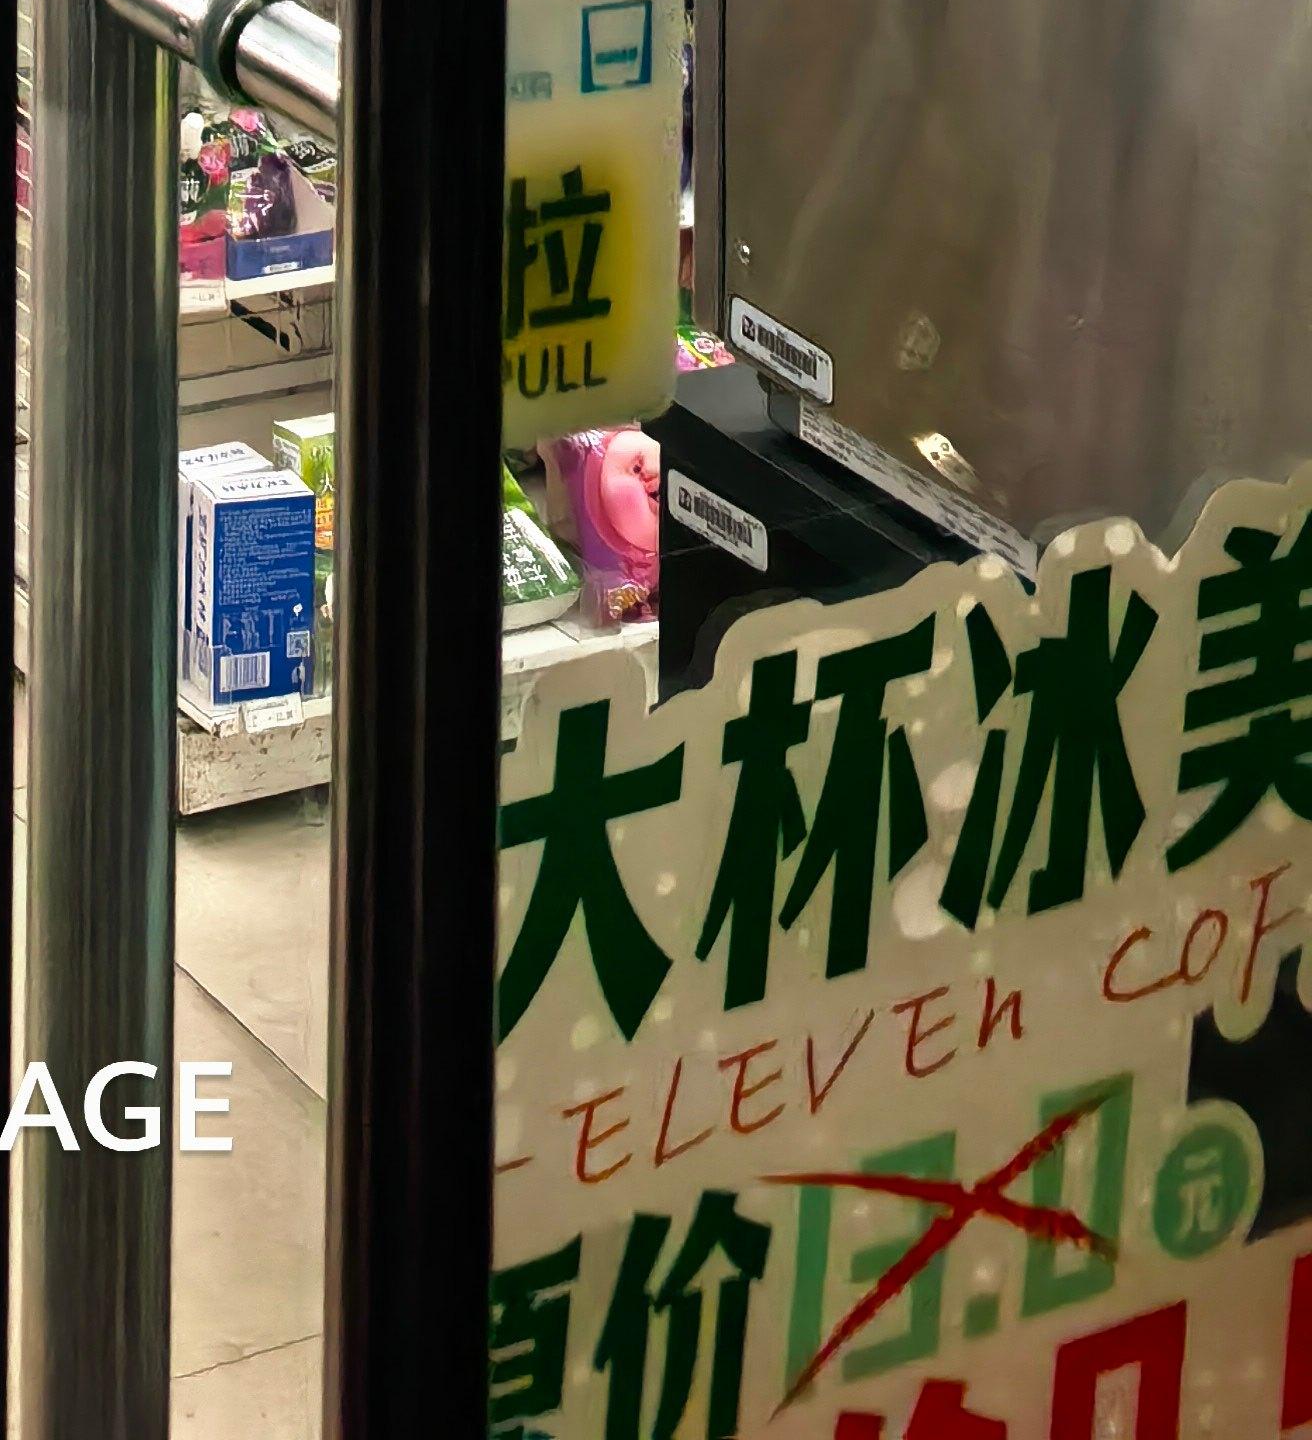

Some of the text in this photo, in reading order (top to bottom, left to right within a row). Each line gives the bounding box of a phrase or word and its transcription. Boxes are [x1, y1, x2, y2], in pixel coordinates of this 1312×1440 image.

[503, 340, 607, 400] ULL
[495, 525, 1312, 1045] 大杯冰美
